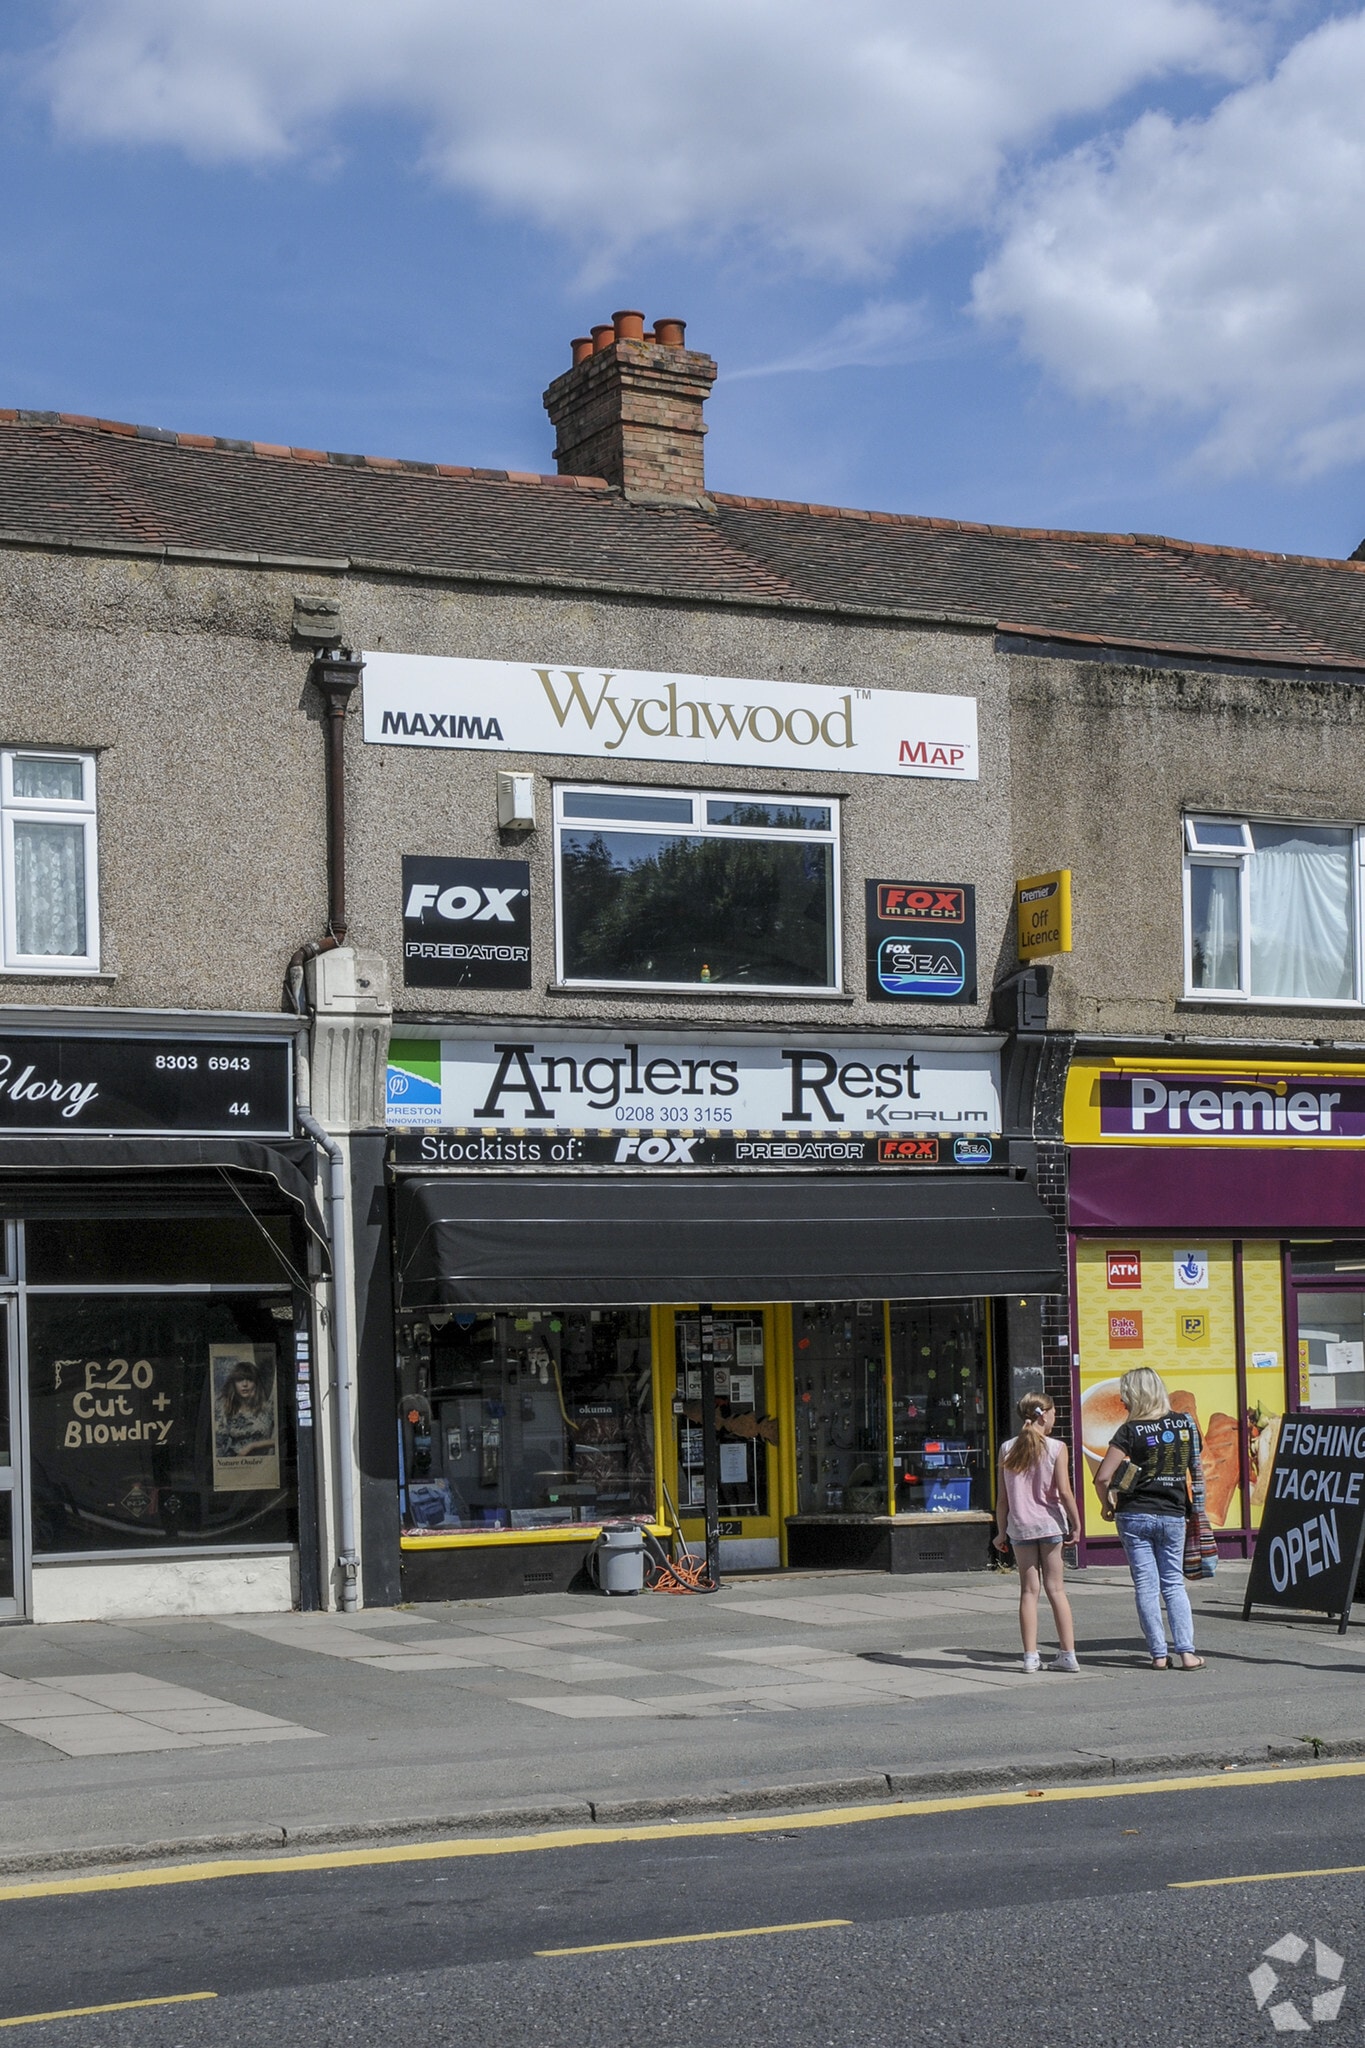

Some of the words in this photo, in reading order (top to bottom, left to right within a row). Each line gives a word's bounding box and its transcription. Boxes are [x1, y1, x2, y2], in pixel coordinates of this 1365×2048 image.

[531, 668, 859, 750] Wychwood
[381, 710, 505, 741] MAXIMA
[404, 884, 521, 922] FOX
[885, 889, 958, 910] FOX
[1021, 886, 1050, 903] Premier
[885, 906, 957, 918] MATCH
[1031, 909, 1049, 928] Off
[1021, 928, 1060, 948] Licence
[405, 942, 529, 961] PREDATOR
[885, 943, 912, 955] FOX
[892, 953, 958, 975] SEA
[155, 1054, 198, 1070] 8303
[207, 1056, 251, 1071] 6943
[473, 1043, 739, 1119] Anglers
[781, 1049, 921, 1122] Rest
[228, 1102, 251, 1116] 44
[386, 1107, 442, 1116] PRESTON
[615, 1106, 655, 1121] 0208
[659, 1106, 689, 1122] 303
[694, 1107, 733, 1122] 3155
[1131, 1077, 1341, 1132] Premier
[866, 1103, 988, 1126] KORUM
[420, 1136, 541, 1160] Stockists
[550, 1137, 583, 1161] of:
[614, 1137, 699, 1163] FOX
[736, 1143, 864, 1159] PREDATOR
[884, 1141, 934, 1155] FOX
[960, 1144, 989, 1154] SEA
[1110, 1264, 1138, 1276] ATM
[1111, 1318, 1135, 1328] Bake
[84, 1358, 154, 1391] £20
[72, 1391, 134, 1419] Cut
[578, 1404, 613, 1414] okuma
[64, 1419, 174, 1448] Blowdry
[1135, 1422, 1162, 1437] PINK
[1274, 1467, 1365, 1505] TACKLE
[1269, 1507, 1342, 1593] OPEN
